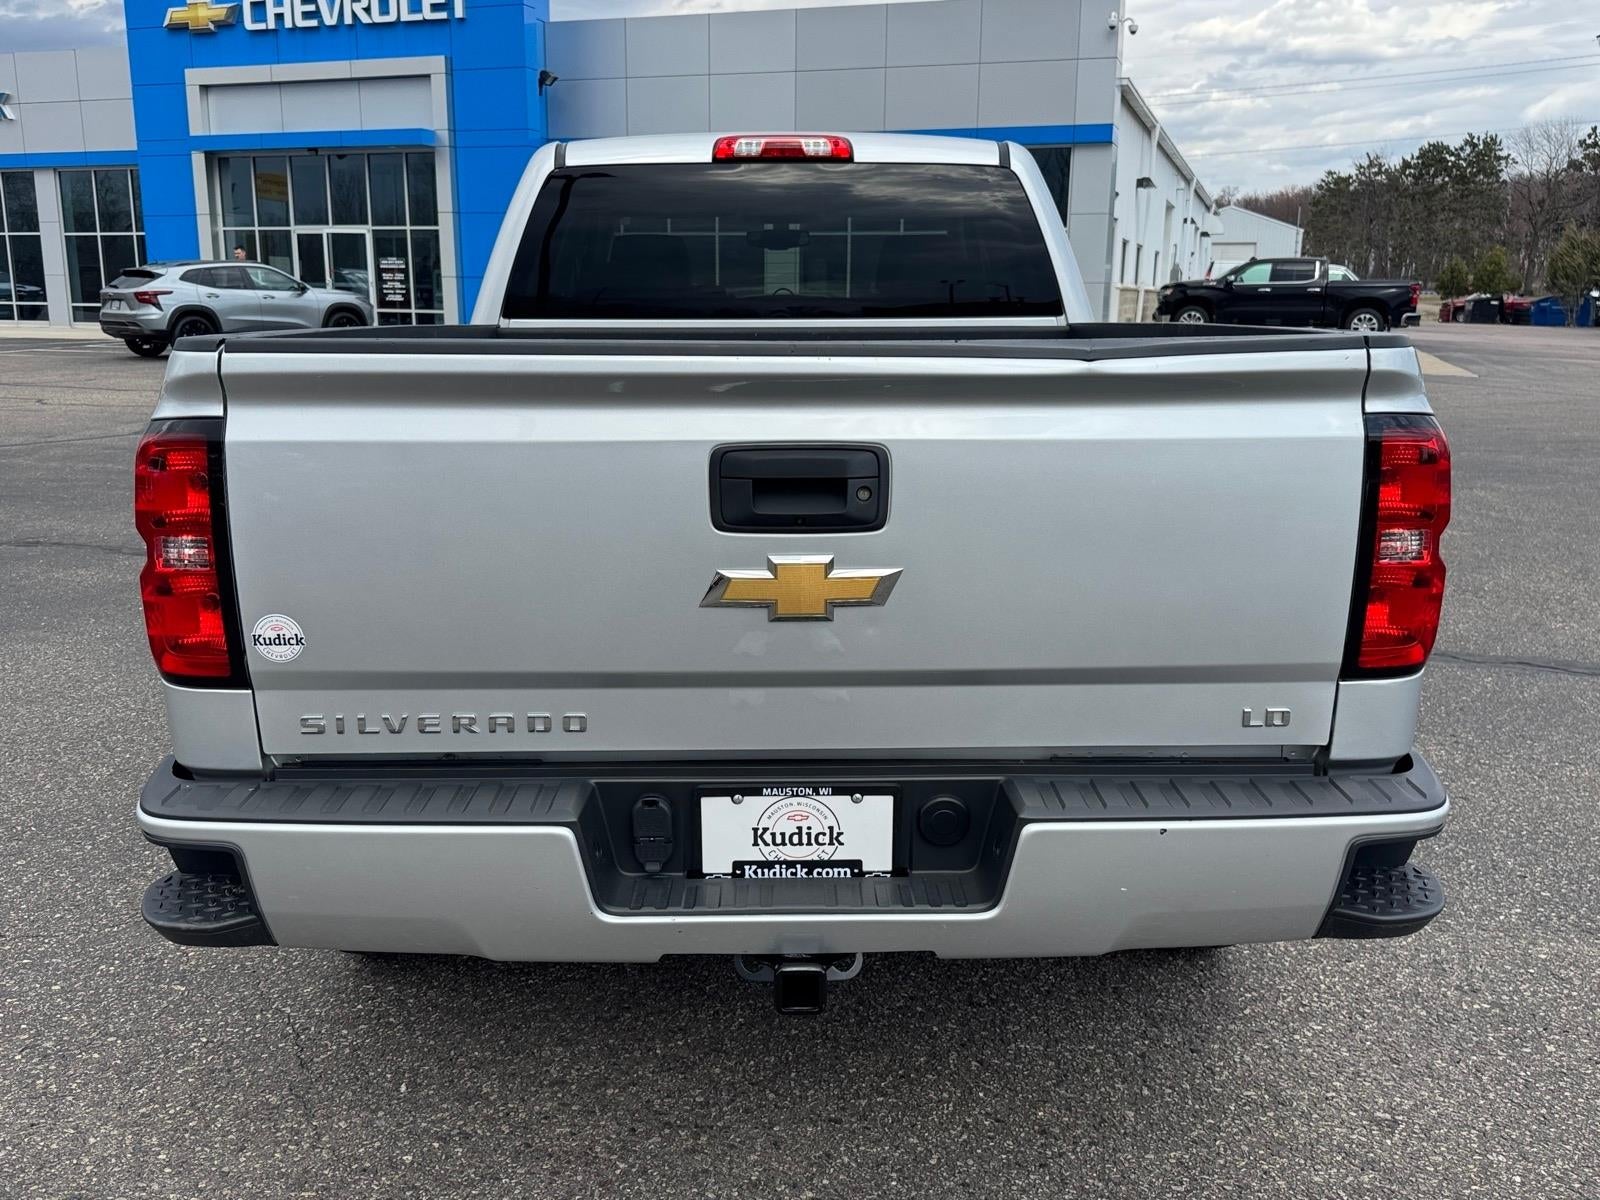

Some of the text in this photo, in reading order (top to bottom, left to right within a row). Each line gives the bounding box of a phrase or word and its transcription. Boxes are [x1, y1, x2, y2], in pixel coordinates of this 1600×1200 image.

[252, 633, 305, 646] Kudick
[263, 647, 298, 659] CHEVROLET
[300, 712, 589, 735] SILVERADO
[1242, 707, 1291, 728] LD
[762, 788, 816, 796] MAUSTON,
[752, 826, 844, 847] Kudick
[744, 865, 851, 879] Kudick.com
